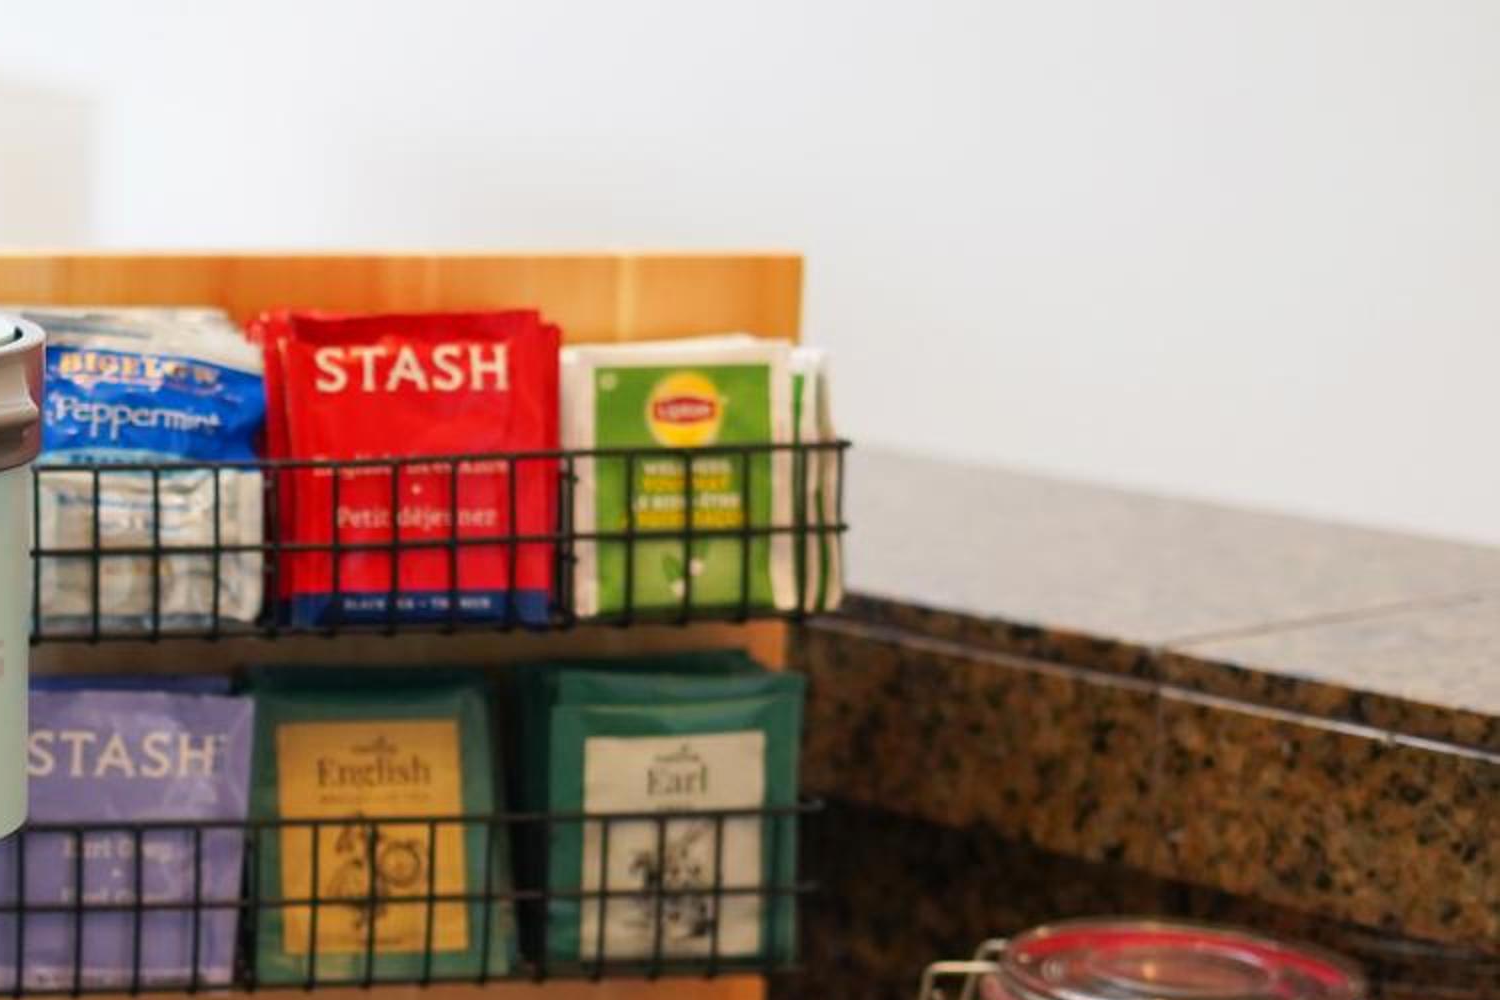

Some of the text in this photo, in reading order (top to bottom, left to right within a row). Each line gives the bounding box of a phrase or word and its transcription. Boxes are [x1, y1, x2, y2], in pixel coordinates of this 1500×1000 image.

[314, 344, 509, 393] STASH
[28, 730, 215, 777] STASH
[316, 755, 431, 787] English
[647, 764, 708, 794] Earl
